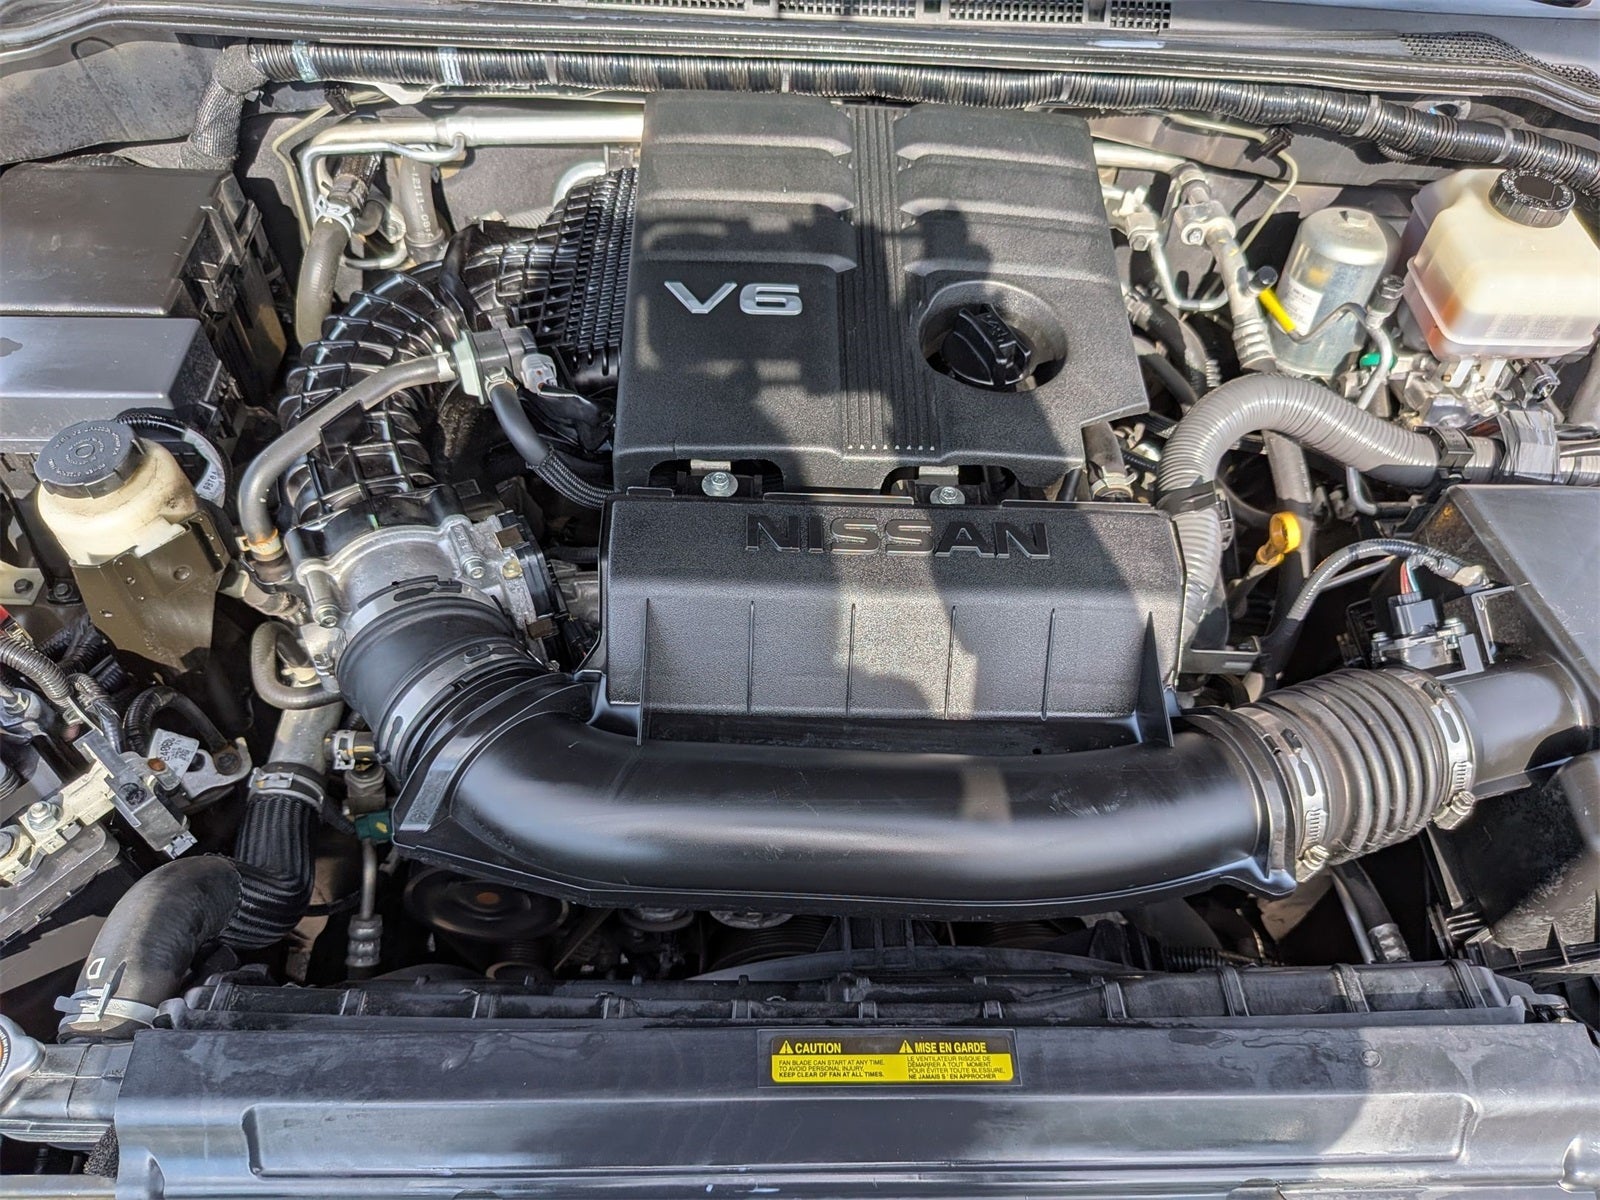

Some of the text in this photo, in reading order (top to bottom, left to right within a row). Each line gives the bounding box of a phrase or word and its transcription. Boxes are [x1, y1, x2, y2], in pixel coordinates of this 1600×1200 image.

[664, 281, 803, 316] V6
[746, 515, 1050, 559] NISSAN
[795, 1043, 841, 1053] CAUTION
[914, 1042, 987, 1053] MISE EN GARDE
